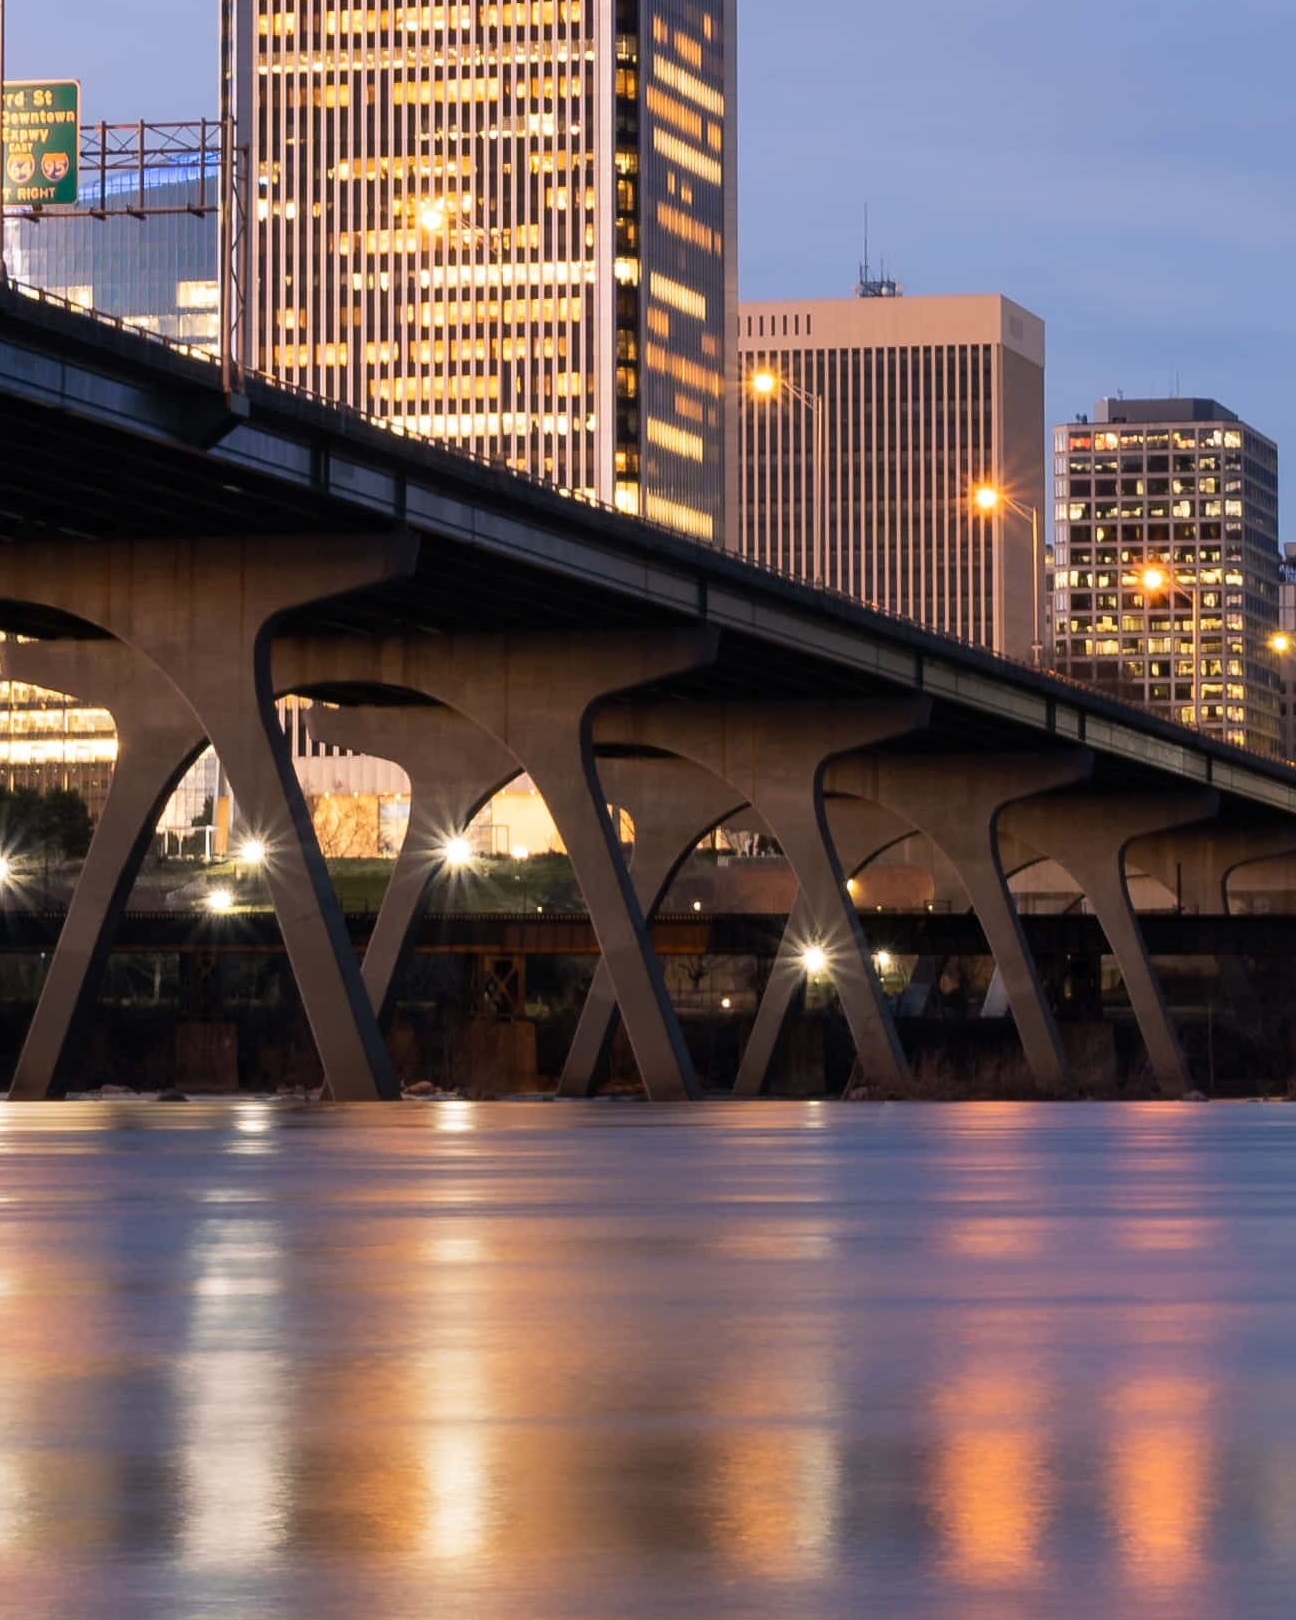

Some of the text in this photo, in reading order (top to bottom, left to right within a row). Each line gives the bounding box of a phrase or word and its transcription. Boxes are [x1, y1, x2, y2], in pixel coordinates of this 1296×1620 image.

[34, 89, 53, 107] St
[8, 143, 33, 153] EAST
[44, 162, 66, 177] 95
[17, 187, 56, 200] RIGHT
